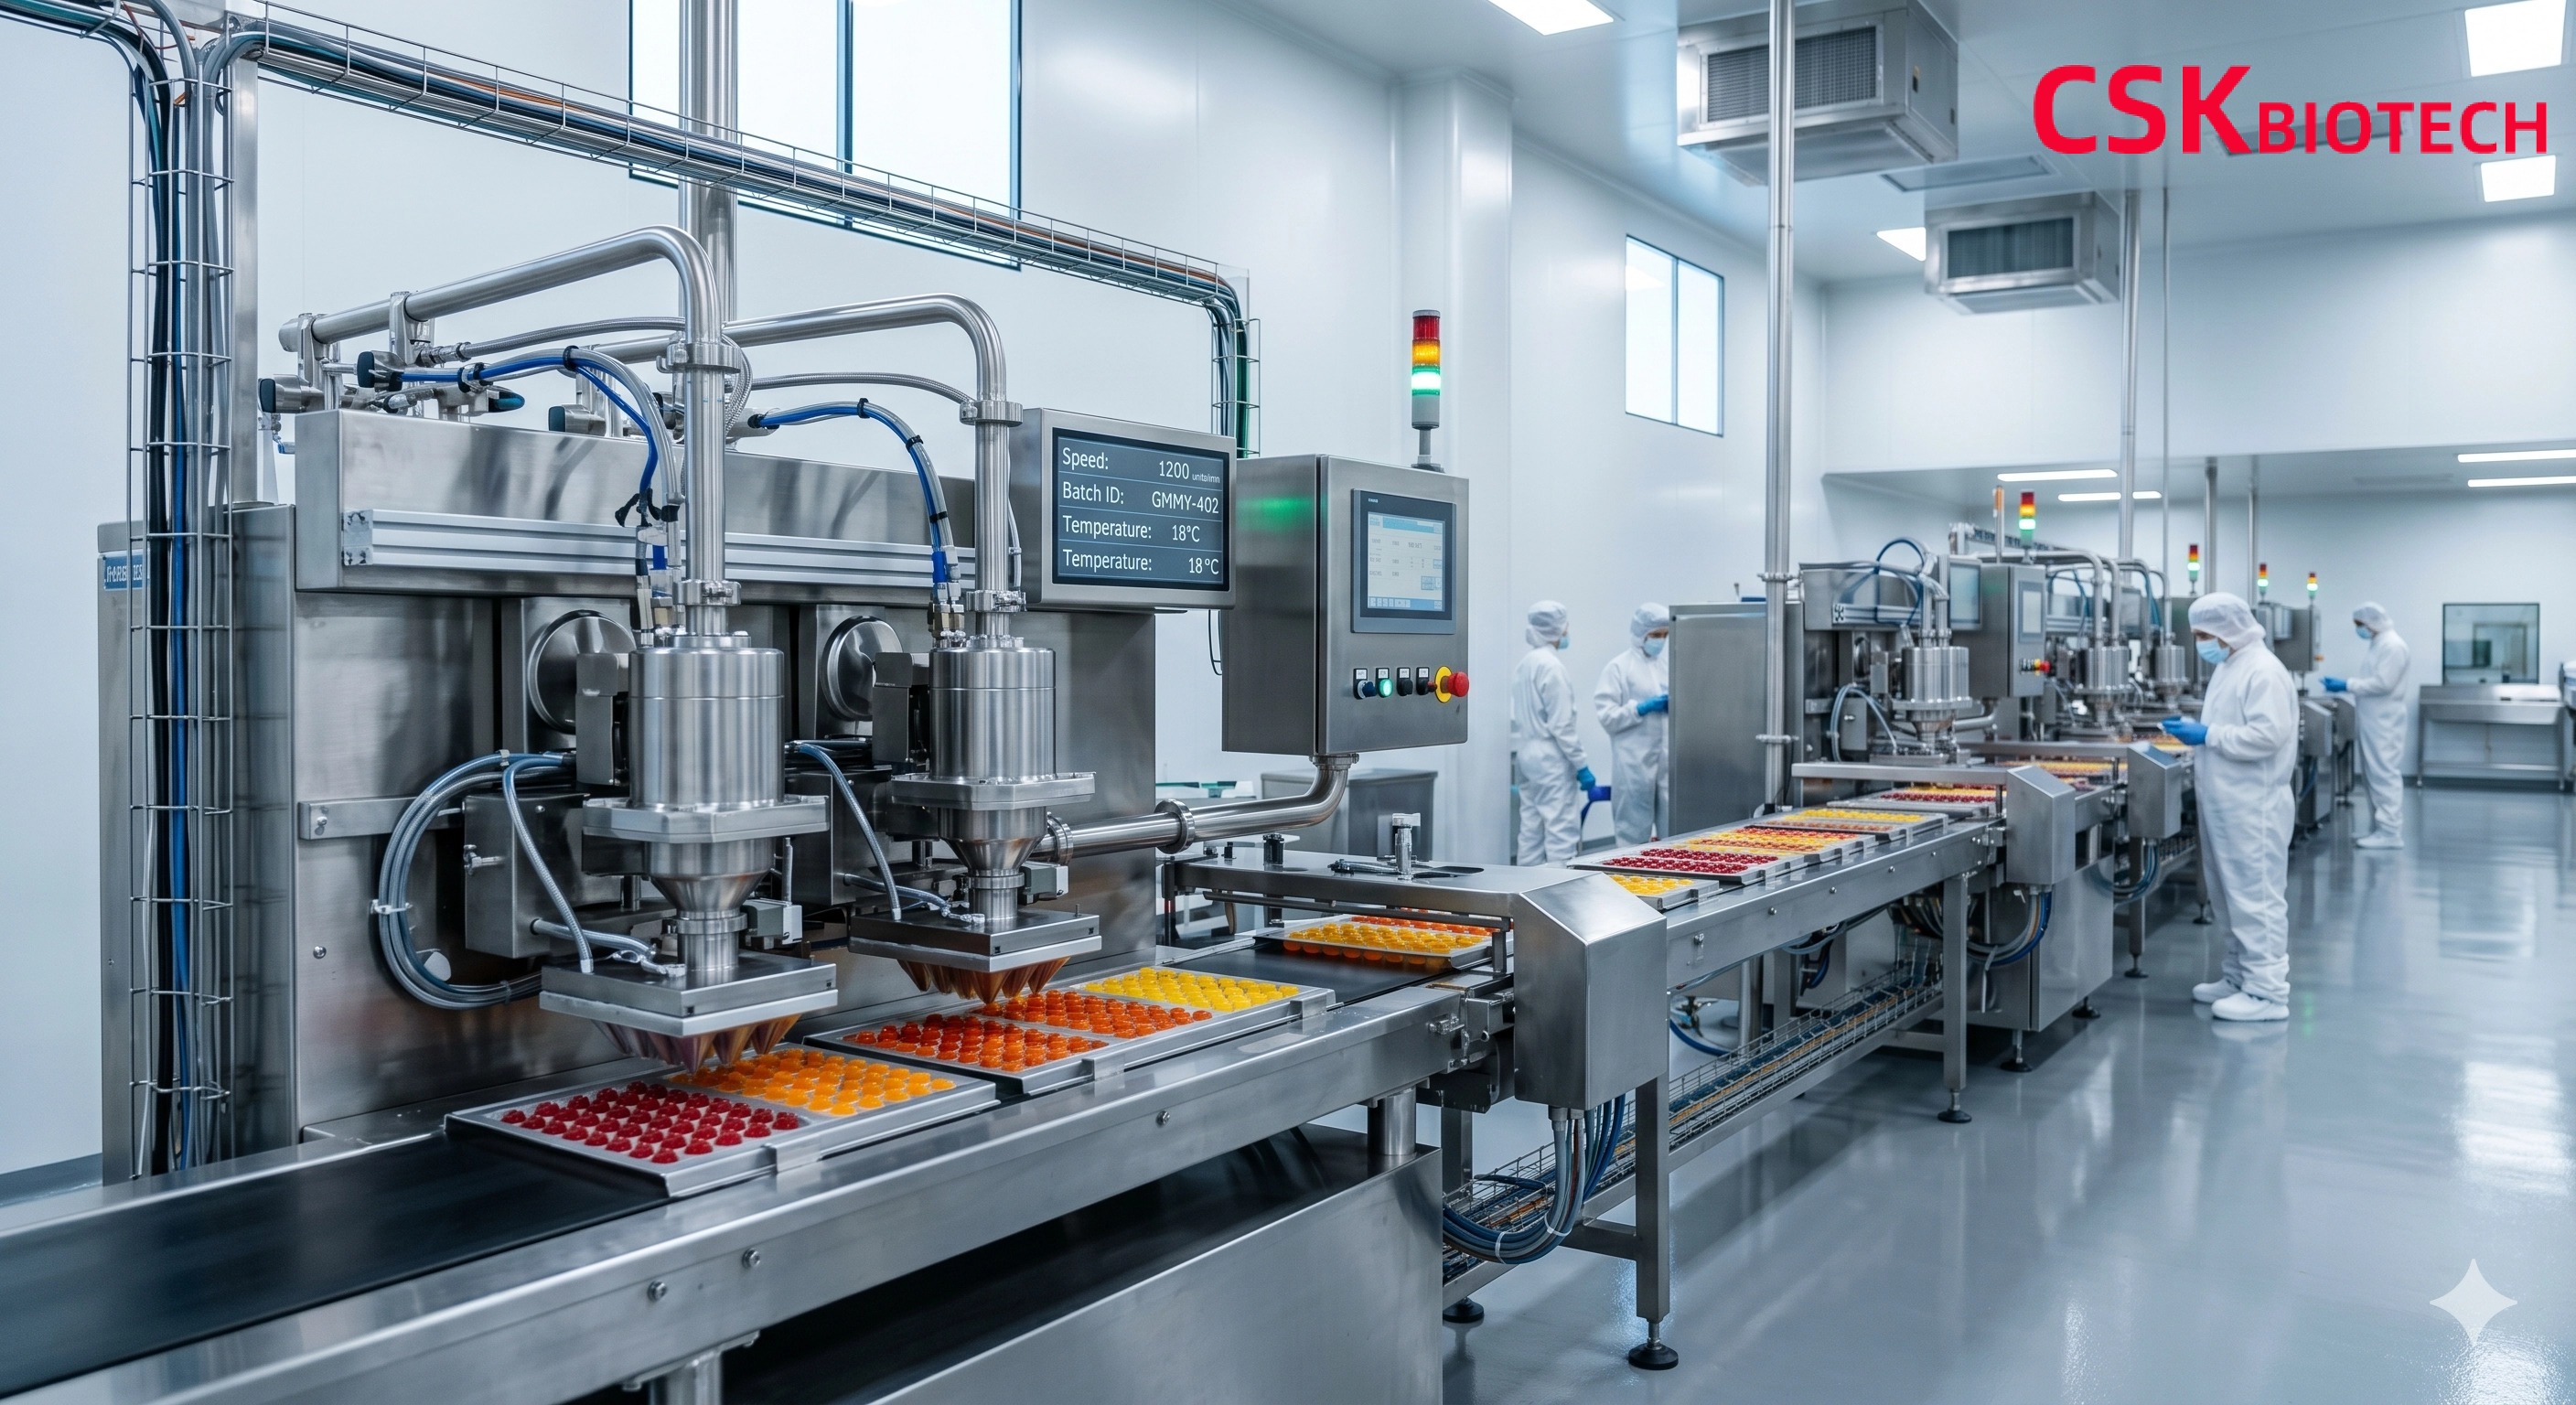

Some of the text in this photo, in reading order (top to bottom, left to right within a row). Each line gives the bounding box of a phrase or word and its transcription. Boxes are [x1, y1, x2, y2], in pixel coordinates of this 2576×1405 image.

[1062, 446, 1109, 470] Speed:
[1159, 460, 1190, 480] 1200
[1063, 481, 1219, 514] Batch ID: GMMY-402
[1062, 515, 1152, 540] Temperature:
[1062, 549, 1152, 573] Temperature:
